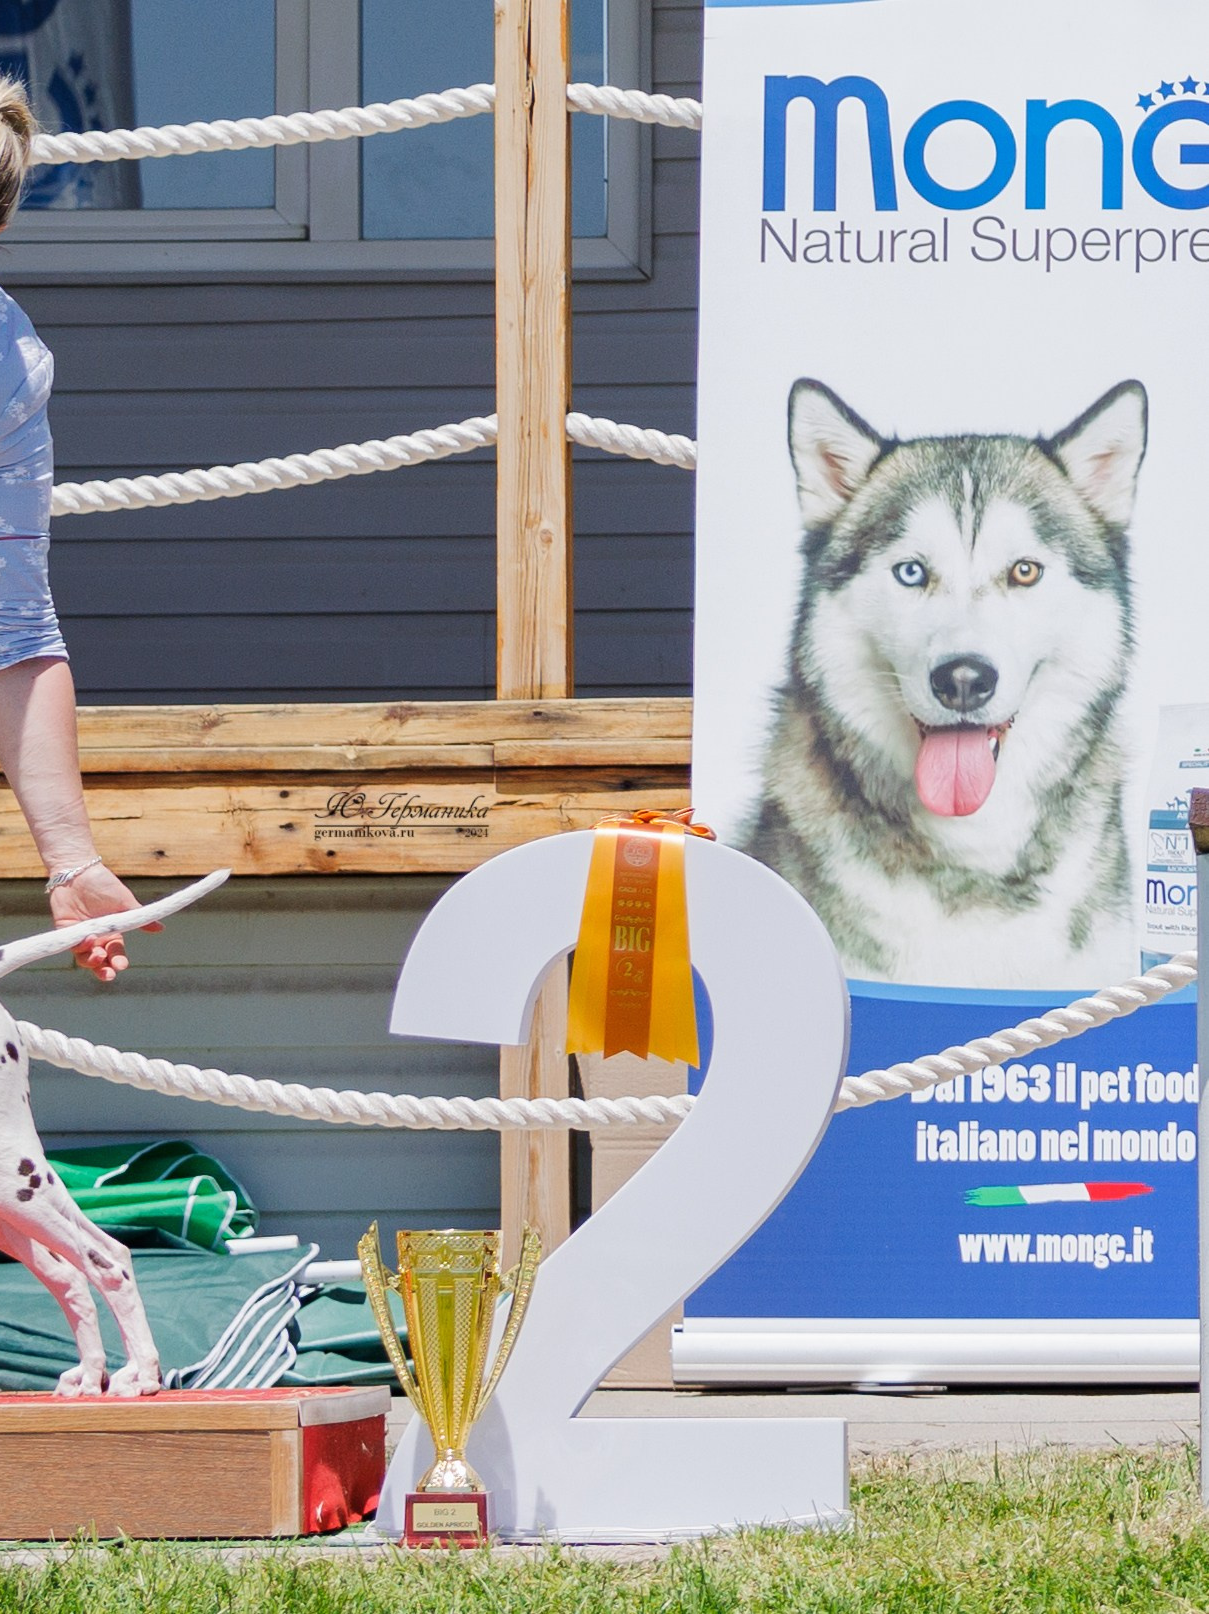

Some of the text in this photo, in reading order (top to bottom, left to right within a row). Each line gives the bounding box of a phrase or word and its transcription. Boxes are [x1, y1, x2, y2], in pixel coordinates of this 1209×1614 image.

[759, 216, 1209, 273] Natural Superpre
[613, 925, 651, 953] BIG
[970, 1063, 1052, 1103] 1963
[1055, 1062, 1076, 1103] il
[1080, 1066, 1130, 1110] pet
[1135, 1063, 1198, 1103] food
[916, 1120, 1196, 1162] italiano nel mondo
[958, 1226, 1154, 1269] www.monge.it
